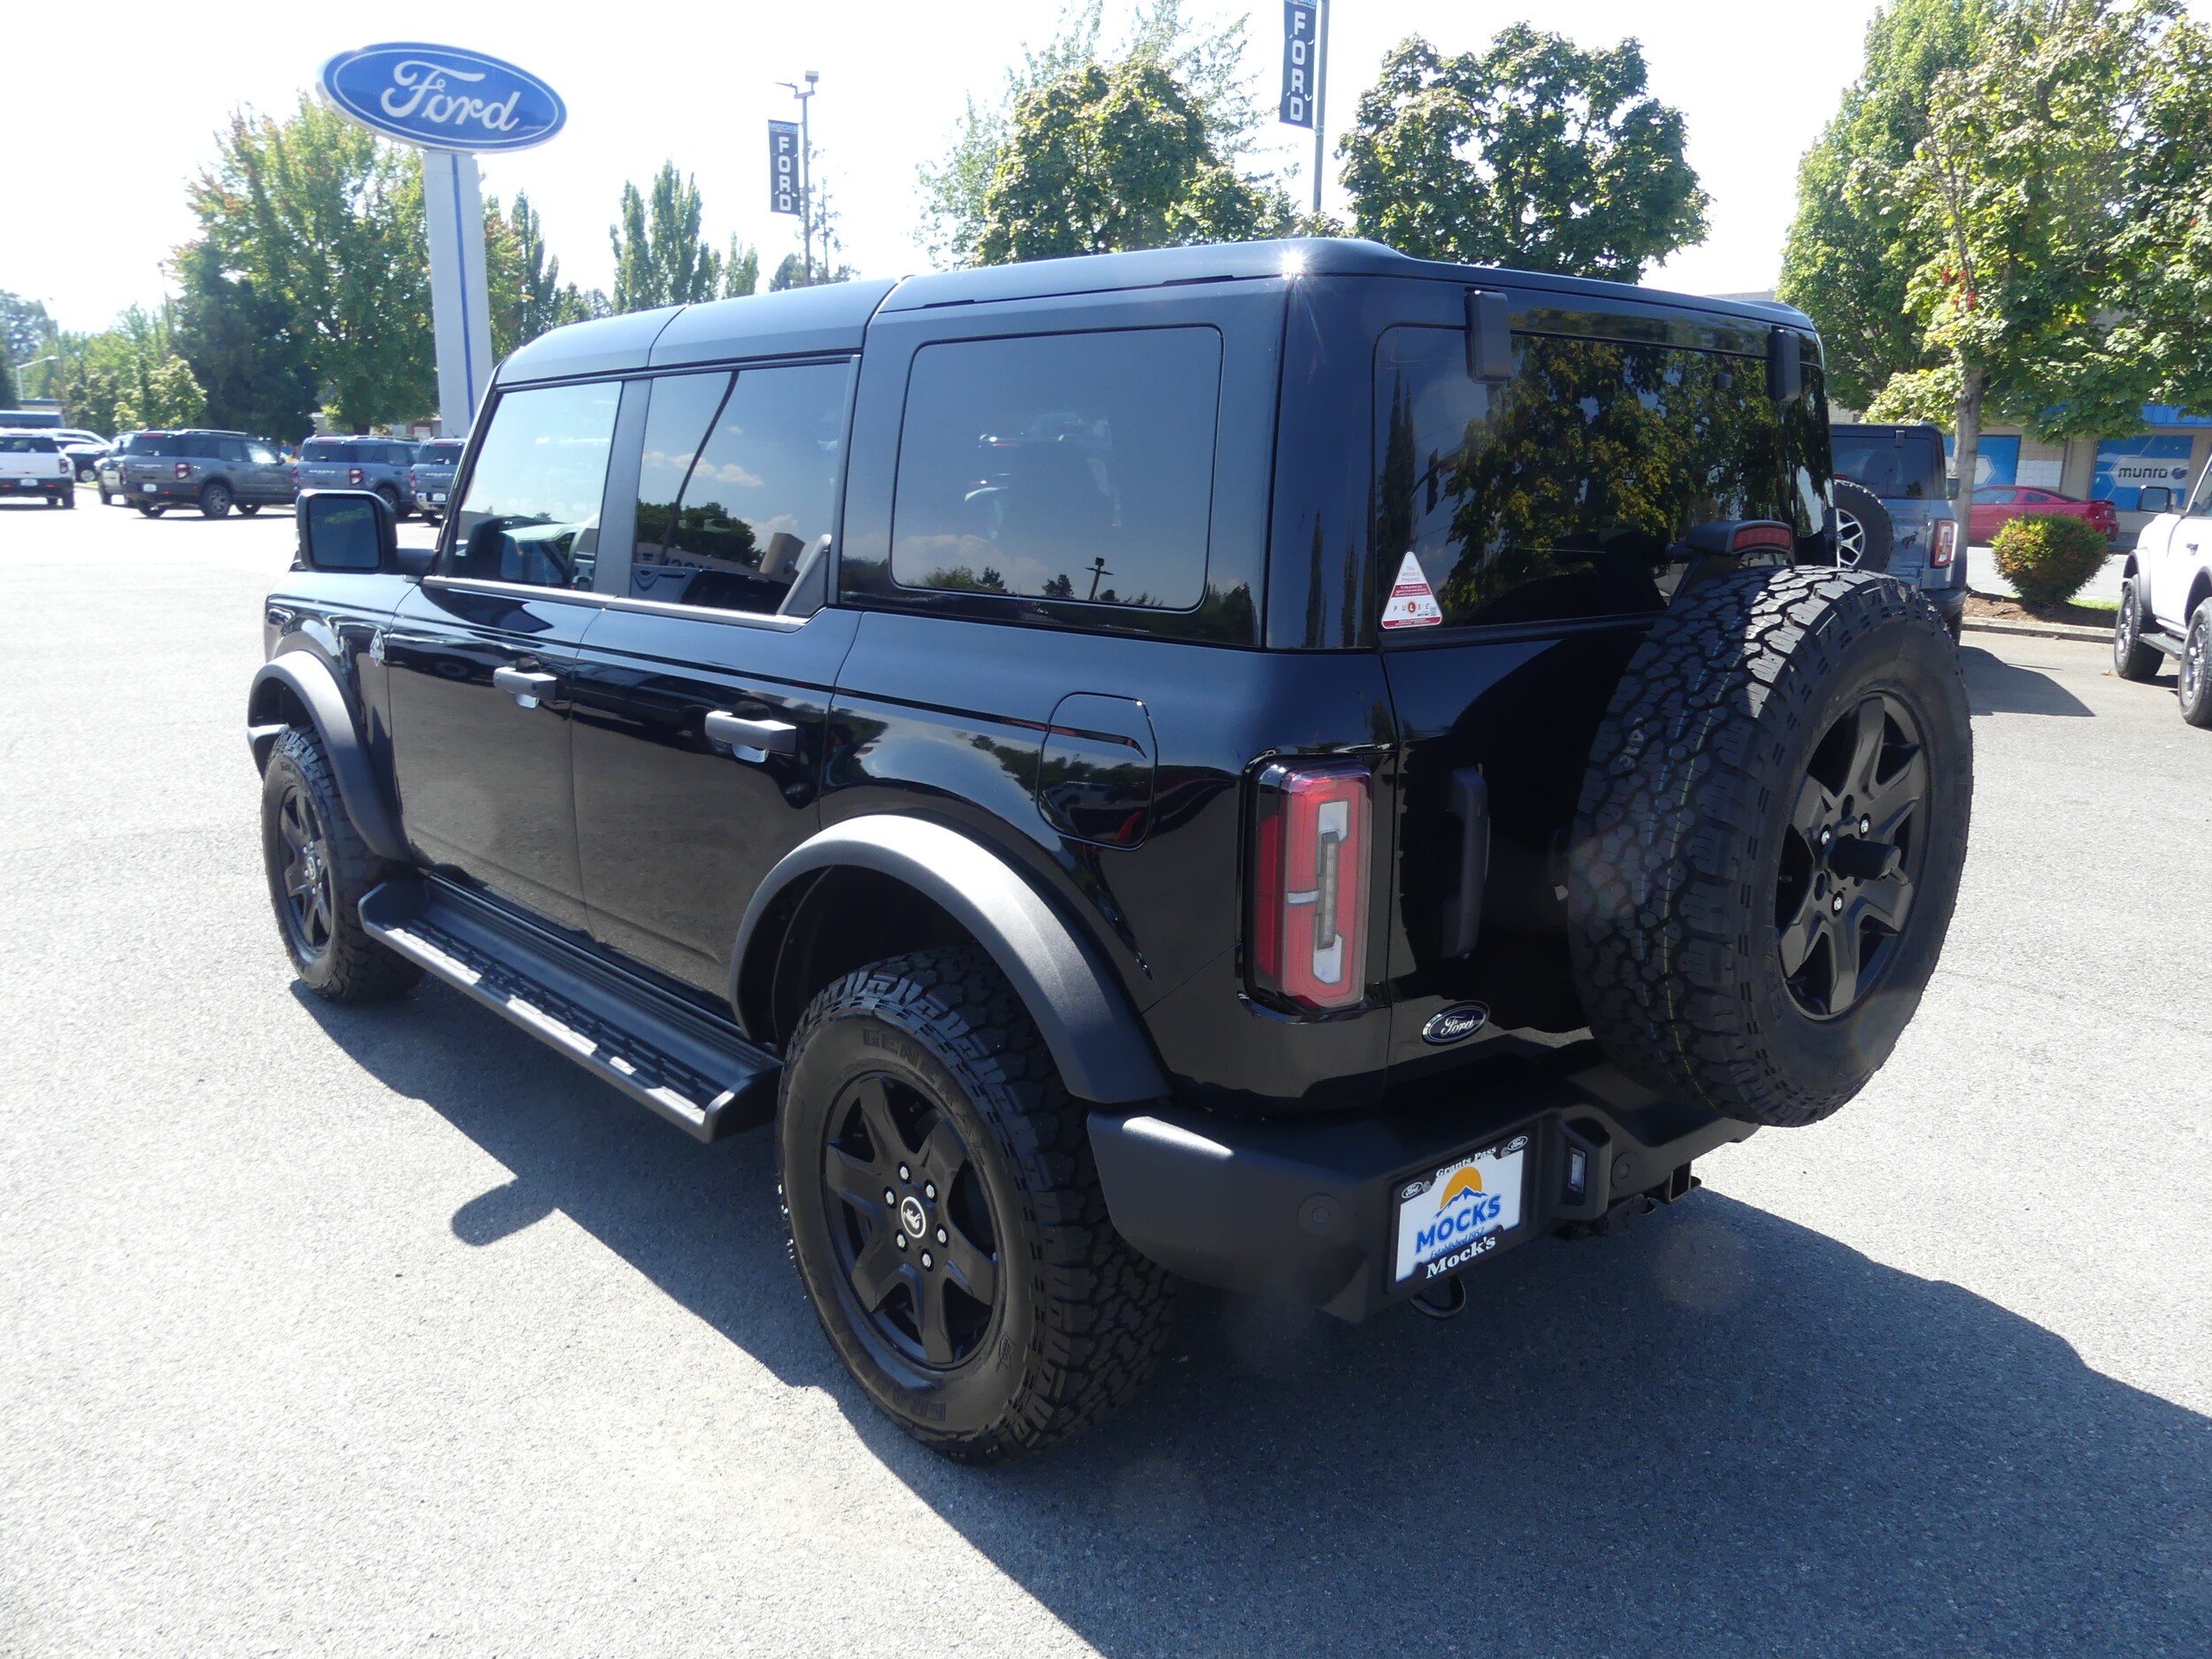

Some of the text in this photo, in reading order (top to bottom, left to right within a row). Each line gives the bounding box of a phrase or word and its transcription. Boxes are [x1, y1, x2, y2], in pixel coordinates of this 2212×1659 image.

[1290, 11, 1306, 121] FORD
[380, 60, 521, 132] Ford
[779, 136, 792, 211] FORD
[2118, 467, 2168, 478] munro
[1394, 603, 1430, 612] PULSE
[1440, 1014, 1475, 1035] Ford
[1436, 1147, 1497, 1178] Grants Pass
[1416, 1194, 1502, 1255] MOCKS
[1469, 1226, 1485, 1239] 1957
[1425, 1236, 1496, 1279] Mock's
